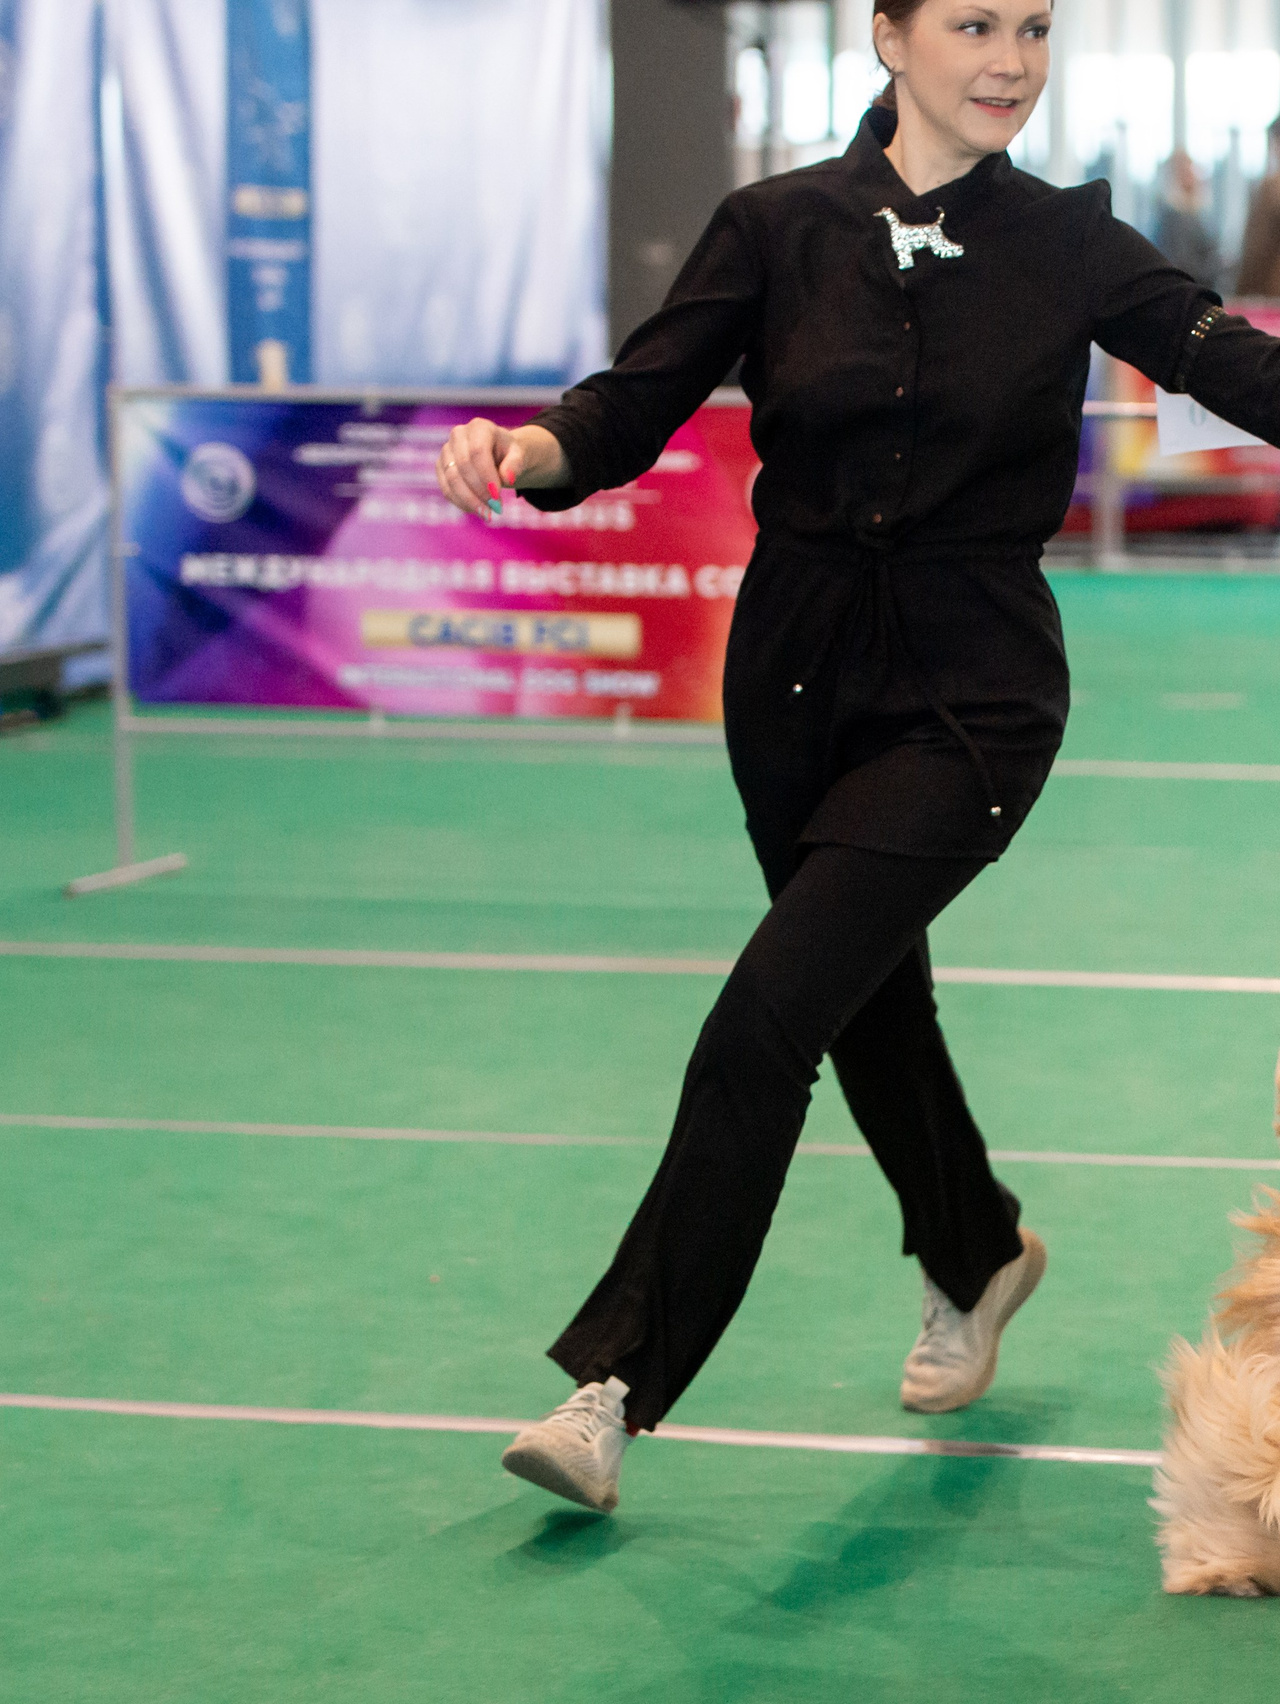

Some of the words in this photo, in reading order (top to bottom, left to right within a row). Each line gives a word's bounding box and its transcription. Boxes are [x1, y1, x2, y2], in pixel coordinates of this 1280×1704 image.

[501, 560, 690, 597] ВЫСТАВКА
[408, 615, 515, 650] CACIB
[532, 619, 589, 653] FCI
